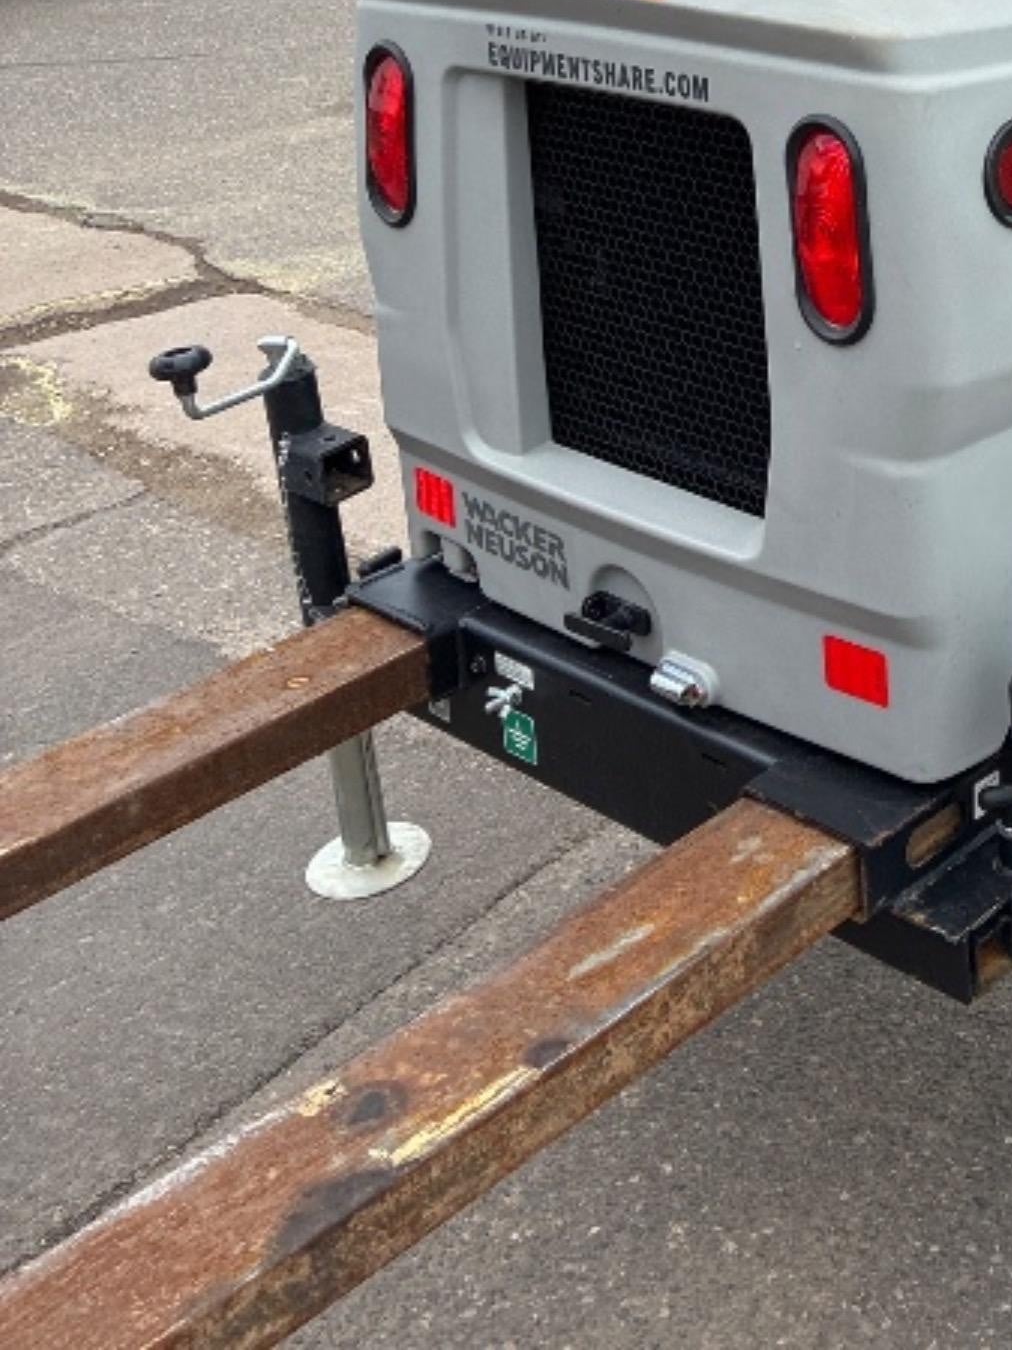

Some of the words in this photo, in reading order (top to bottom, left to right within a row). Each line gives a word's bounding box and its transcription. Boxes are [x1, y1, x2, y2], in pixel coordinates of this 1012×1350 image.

[488, 41, 709, 102] EQUIPMENTSHARE.COM
[462, 491, 567, 565] WACKER
[464, 518, 570, 591] NEUSON
